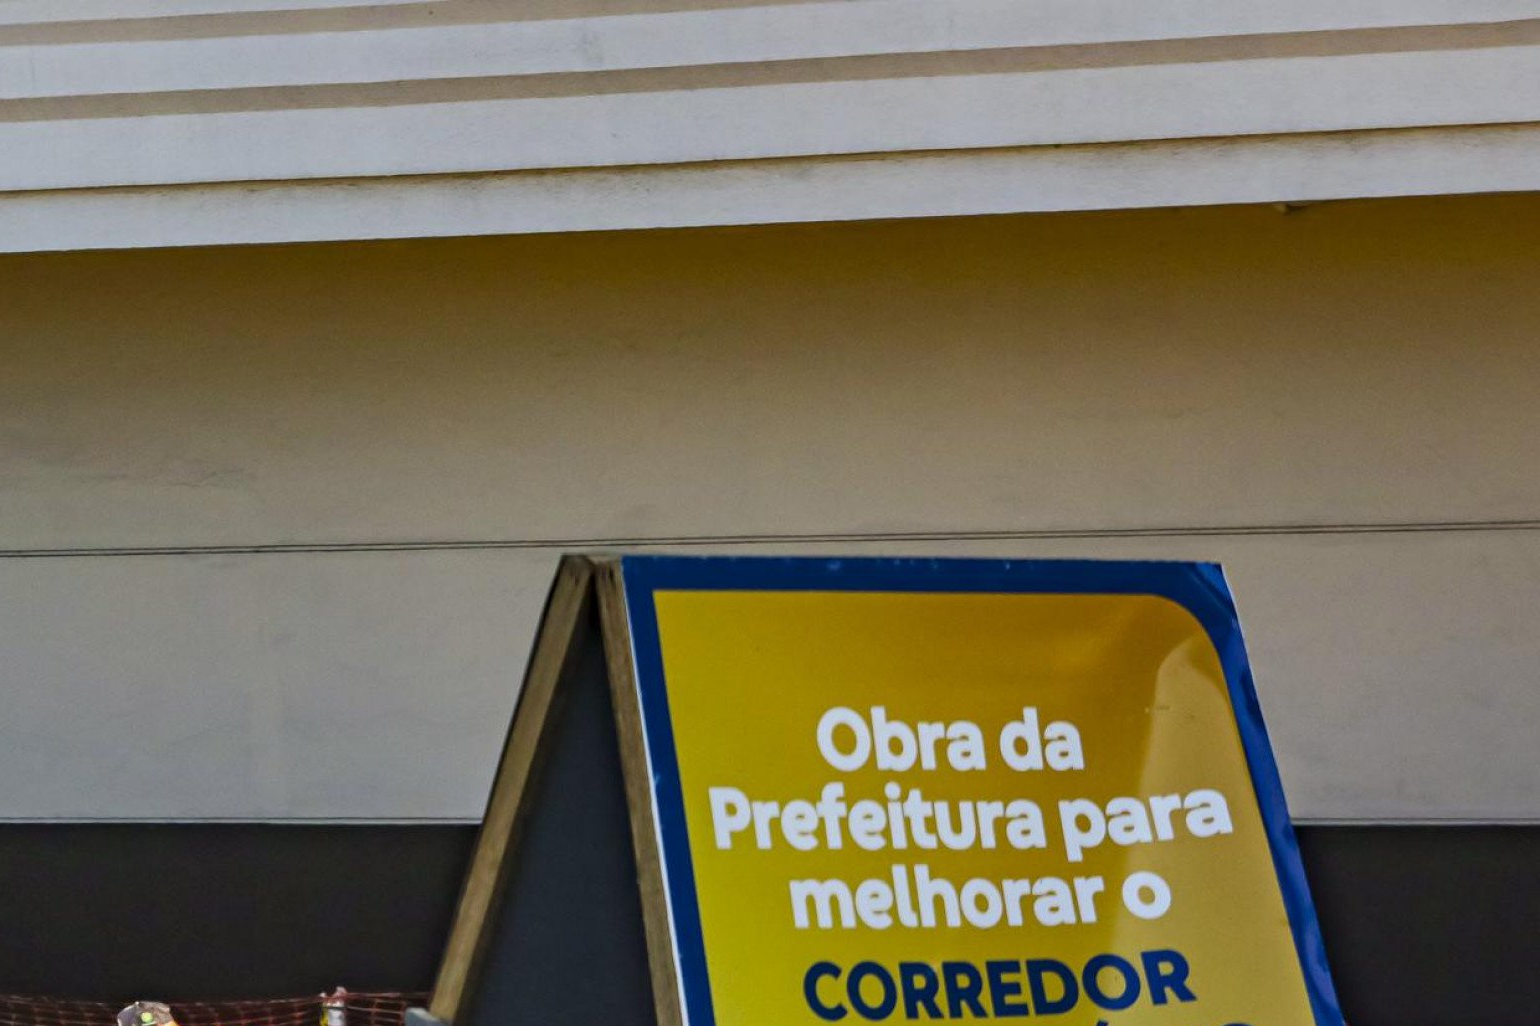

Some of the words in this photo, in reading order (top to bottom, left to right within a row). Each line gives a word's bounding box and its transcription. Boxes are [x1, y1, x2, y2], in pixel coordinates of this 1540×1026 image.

[816, 706, 986, 772] Obra
[999, 707, 1085, 772] da
[708, 782, 1047, 851] Prefeitura
[1058, 787, 1233, 861] para
[788, 864, 1104, 929] melhorar
[1121, 871, 1172, 919] o
[802, 948, 1198, 1022] CORREDOR
